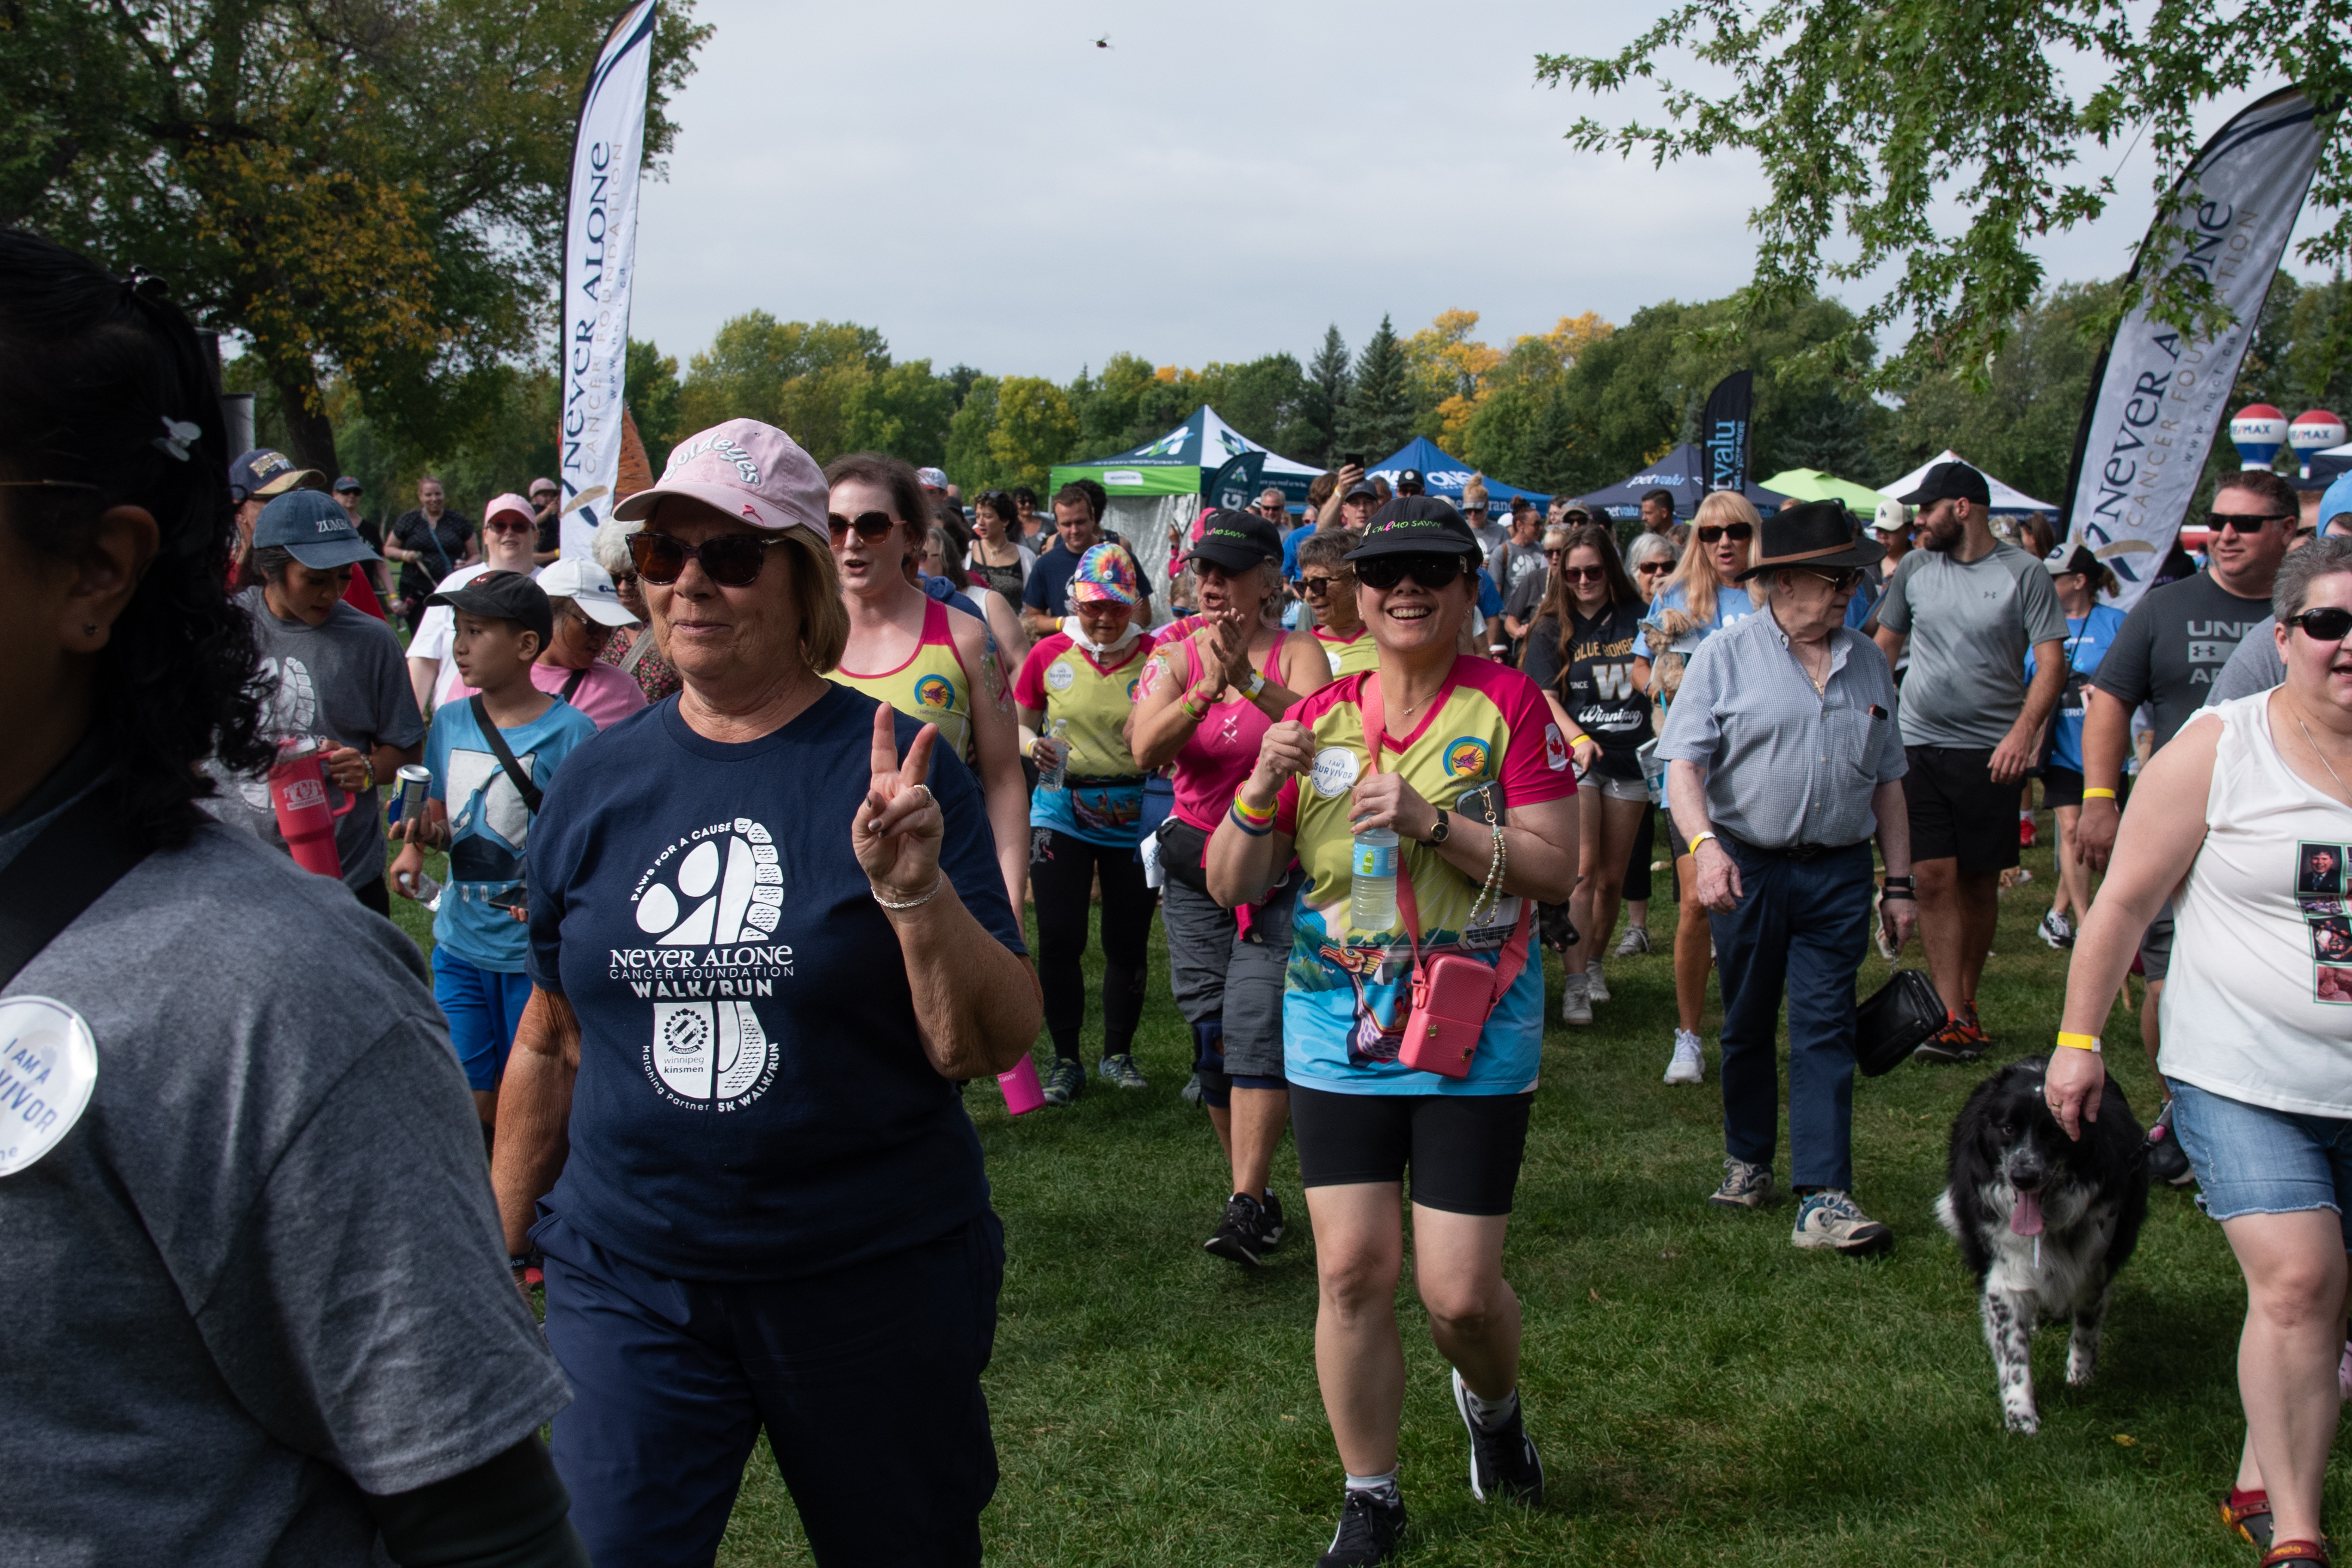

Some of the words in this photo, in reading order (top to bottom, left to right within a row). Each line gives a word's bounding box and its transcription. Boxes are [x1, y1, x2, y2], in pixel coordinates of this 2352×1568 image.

[584, 360, 602, 474] CANCER
[596, 145, 623, 343] FOUNDATION
[2126, 419, 2180, 527] CANCER
[2170, 210, 2259, 403] FOUNATION
[662, 433, 761, 486] Goldeyes
[1626, 473, 1686, 488] petvalu
[1411, 520, 1441, 529] SAVVY
[1313, 762, 1353, 780] SURVIVOR
[630, 868, 655, 902] PAWS
[654, 844, 678, 866] FOR
[680, 837, 689, 847] A
[691, 822, 732, 840] CAUSE
[610, 969, 674, 979] CANCER
[682, 966, 794, 979] FOUNDATION
[630, 979, 773, 998] WALK/RUN
[4, 1037, 19, 1054] I
[11, 1048, 41, 1074] AM
[664, 1056, 705, 1065] winnipeg
[664, 1065, 704, 1074] kinsmen
[35, 1067, 52, 1085] A
[642, 1045, 665, 1095] Matching
[666, 1092, 710, 1111] Partner
[718, 1101, 736, 1113] 5K
[738, 1042, 780, 1108] WALK/RUN
